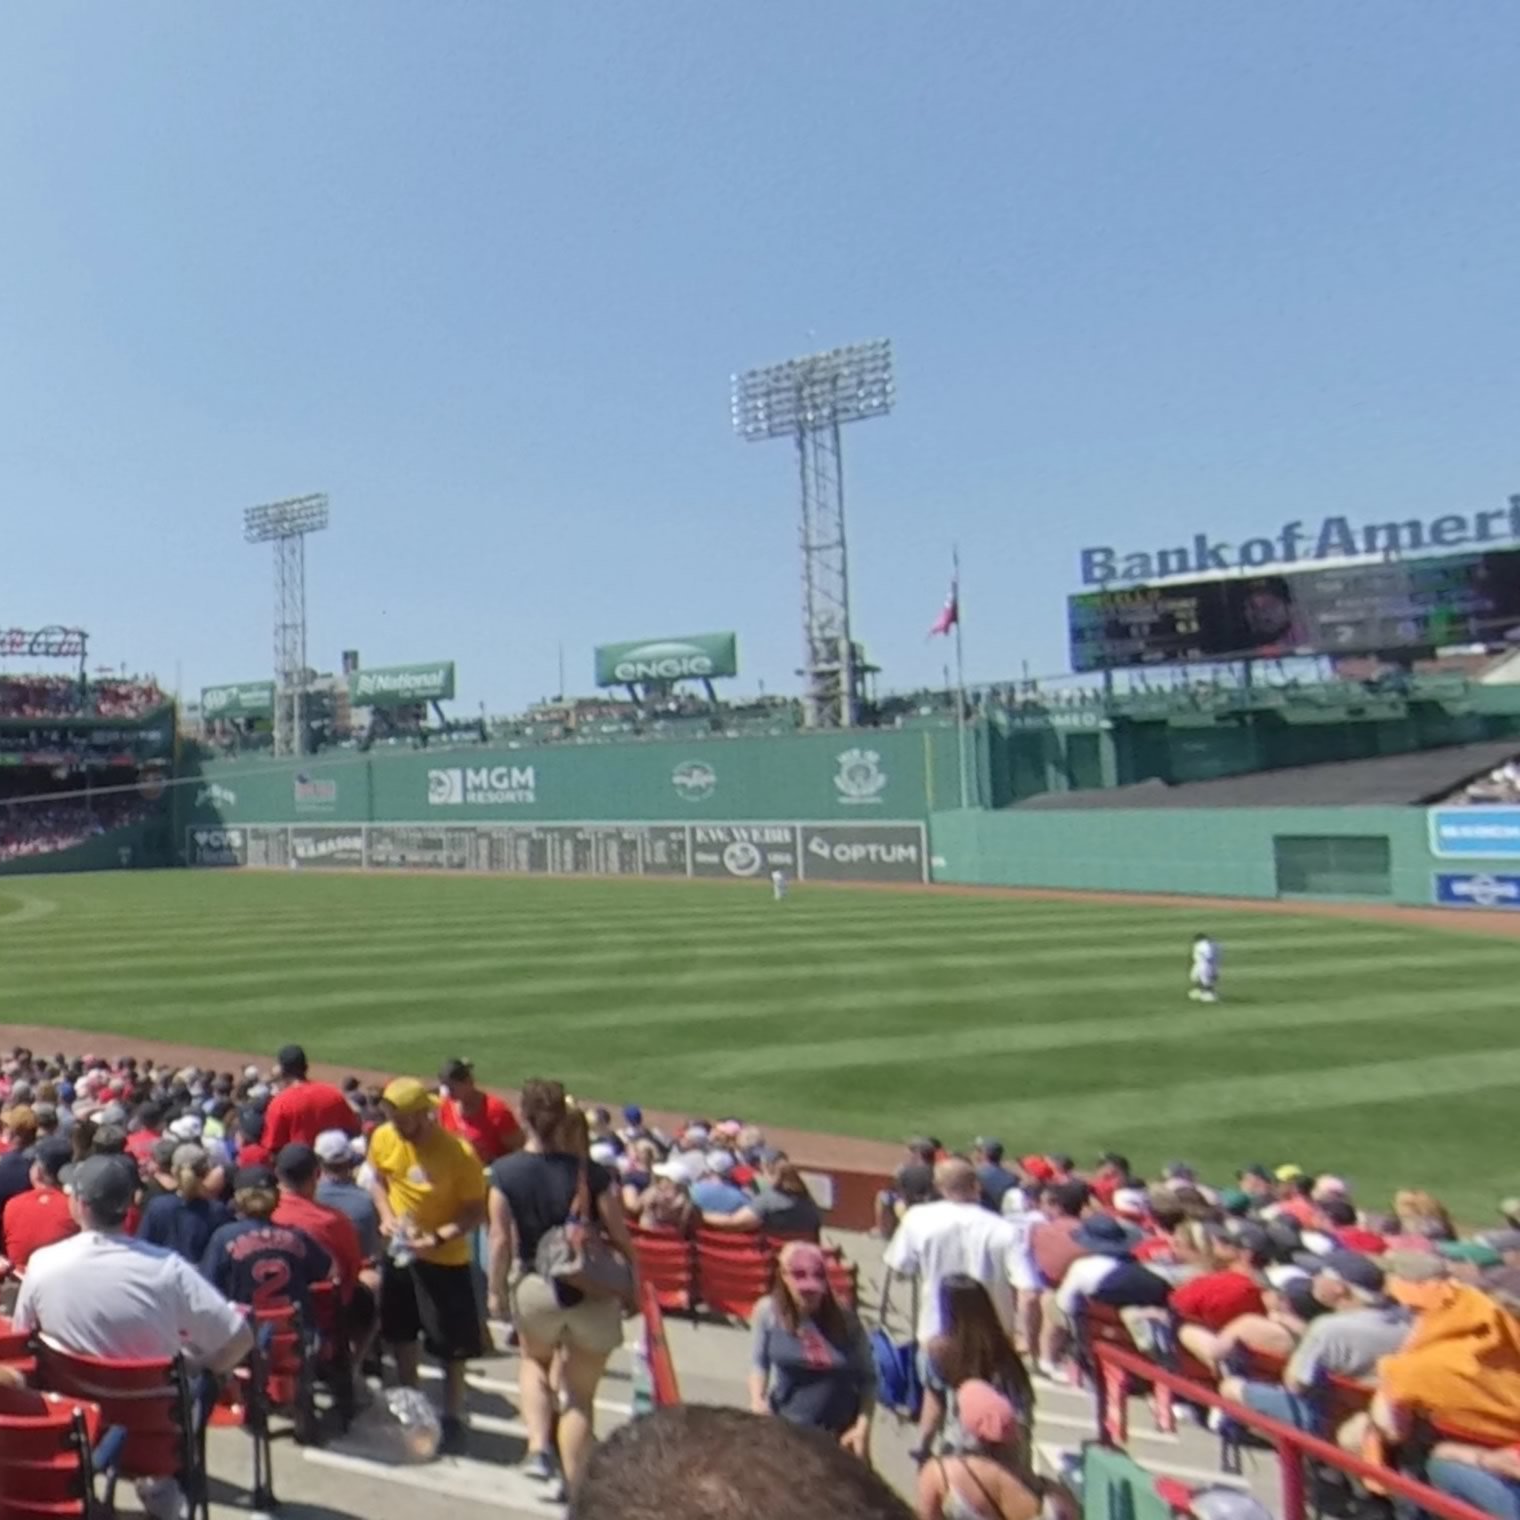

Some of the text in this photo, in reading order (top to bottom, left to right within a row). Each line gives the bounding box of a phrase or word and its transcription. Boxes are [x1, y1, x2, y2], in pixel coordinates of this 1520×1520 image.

[1080, 534, 1233, 585] Bank
[1239, 521, 1303, 568] of
[377, 669, 445, 691] National
[466, 765, 535, 790] MGM
[466, 789, 535, 803] RESORTS
[833, 844, 917, 863] OPTUM
[252, 1258, 291, 1301] 2
